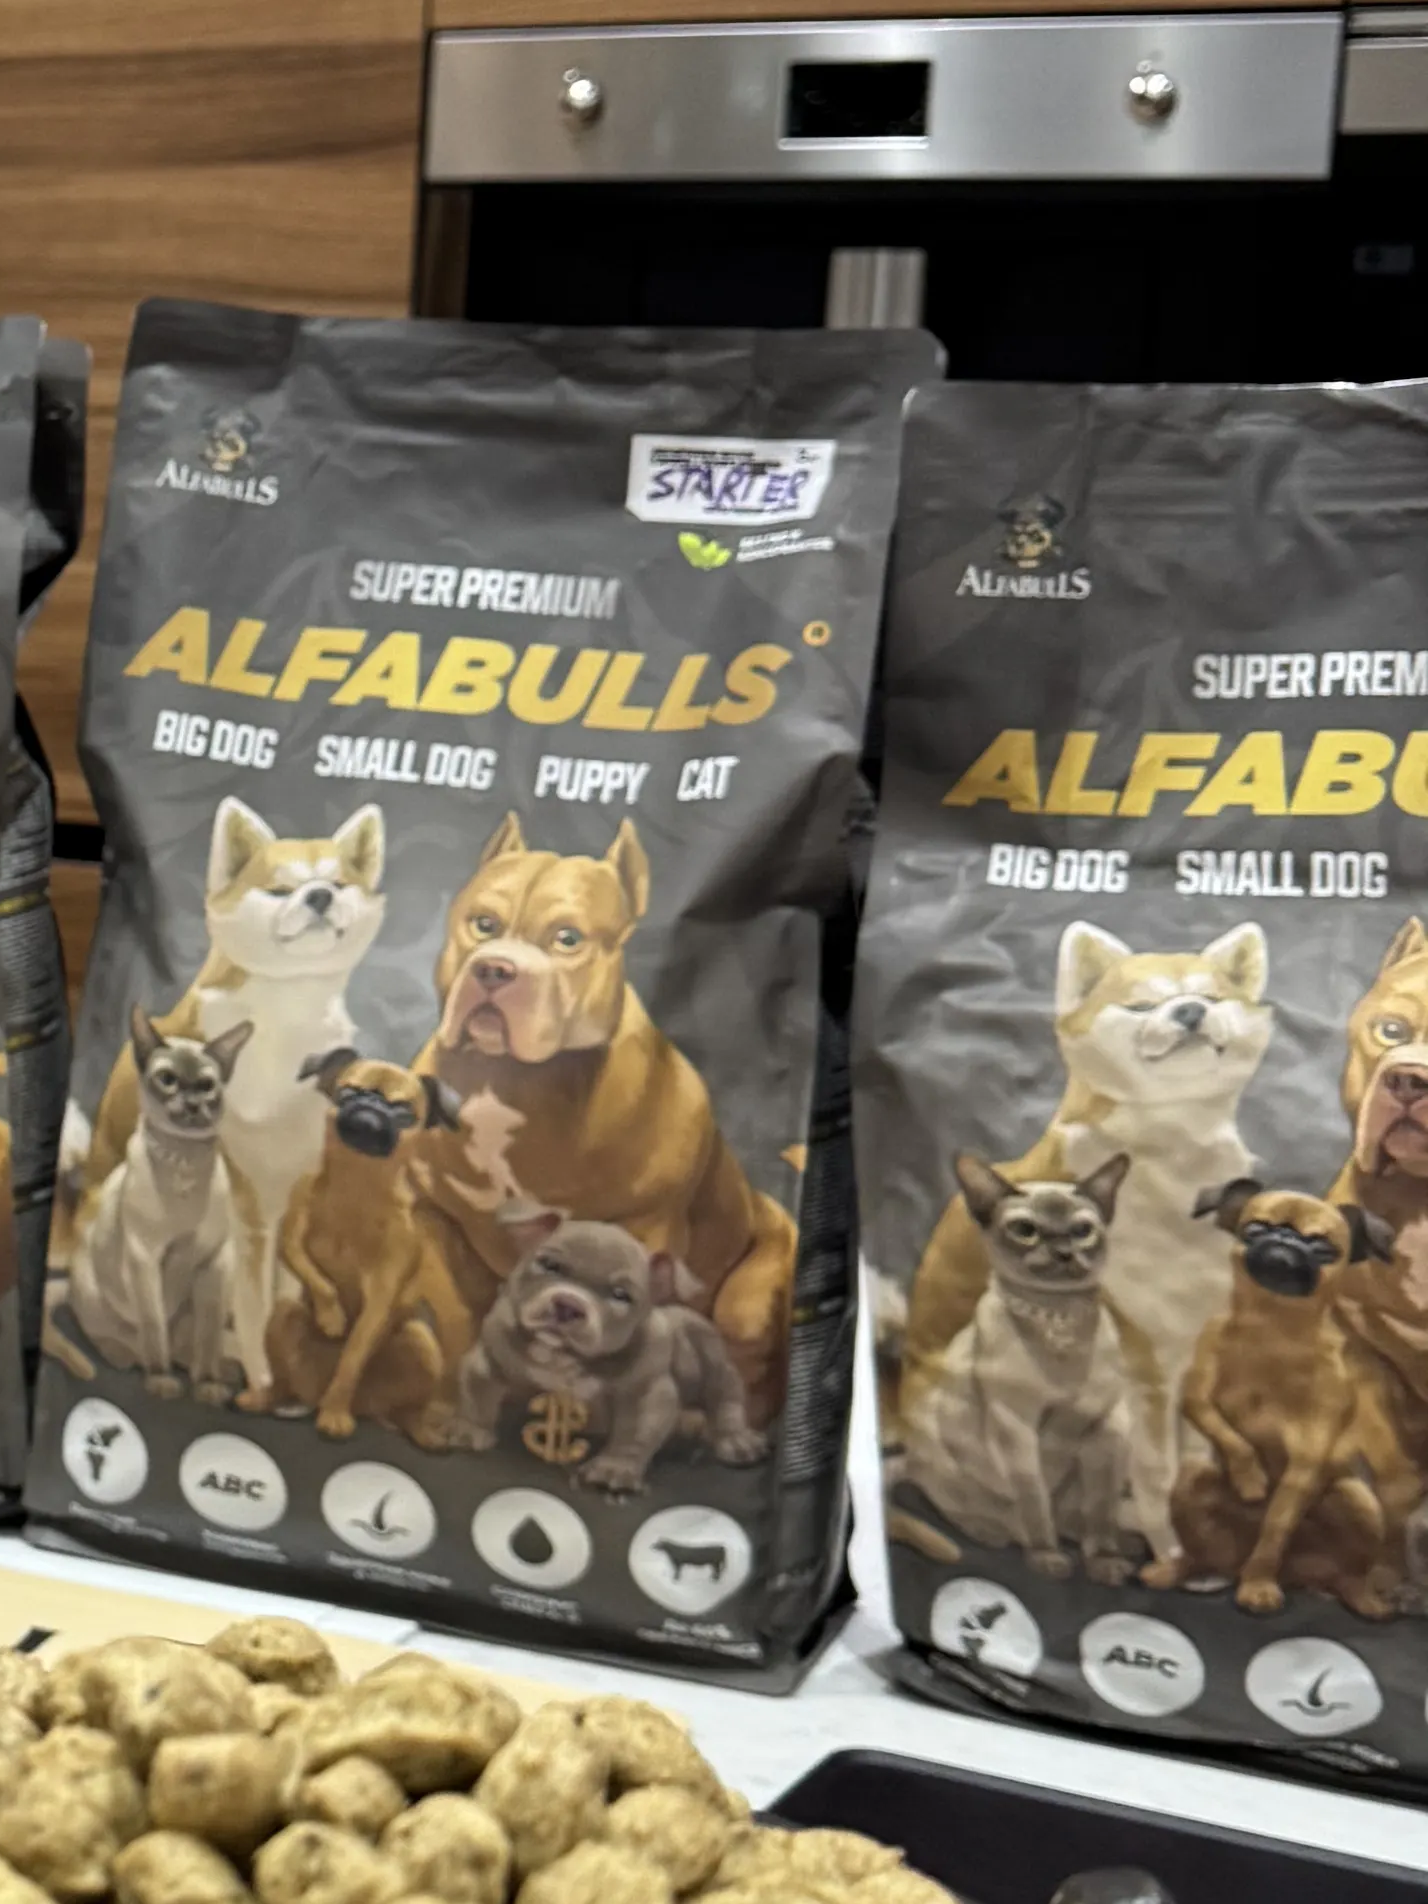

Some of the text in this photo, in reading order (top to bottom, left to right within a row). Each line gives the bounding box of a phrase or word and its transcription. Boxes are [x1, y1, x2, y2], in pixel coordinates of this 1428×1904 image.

[647, 464, 808, 505] STARTER
[350, 559, 622, 619] SUPER PREMIUM
[123, 605, 794, 732] ALFABULLS
[1192, 652, 1316, 699] SUPER
[152, 709, 741, 805] BIG DOG SMALL DOG PUPPY CAT
[986, 843, 1389, 898] BIG DOG SMALL DOG
[197, 1471, 266, 1501] ABC
[1103, 1645, 1180, 1680] ABC
